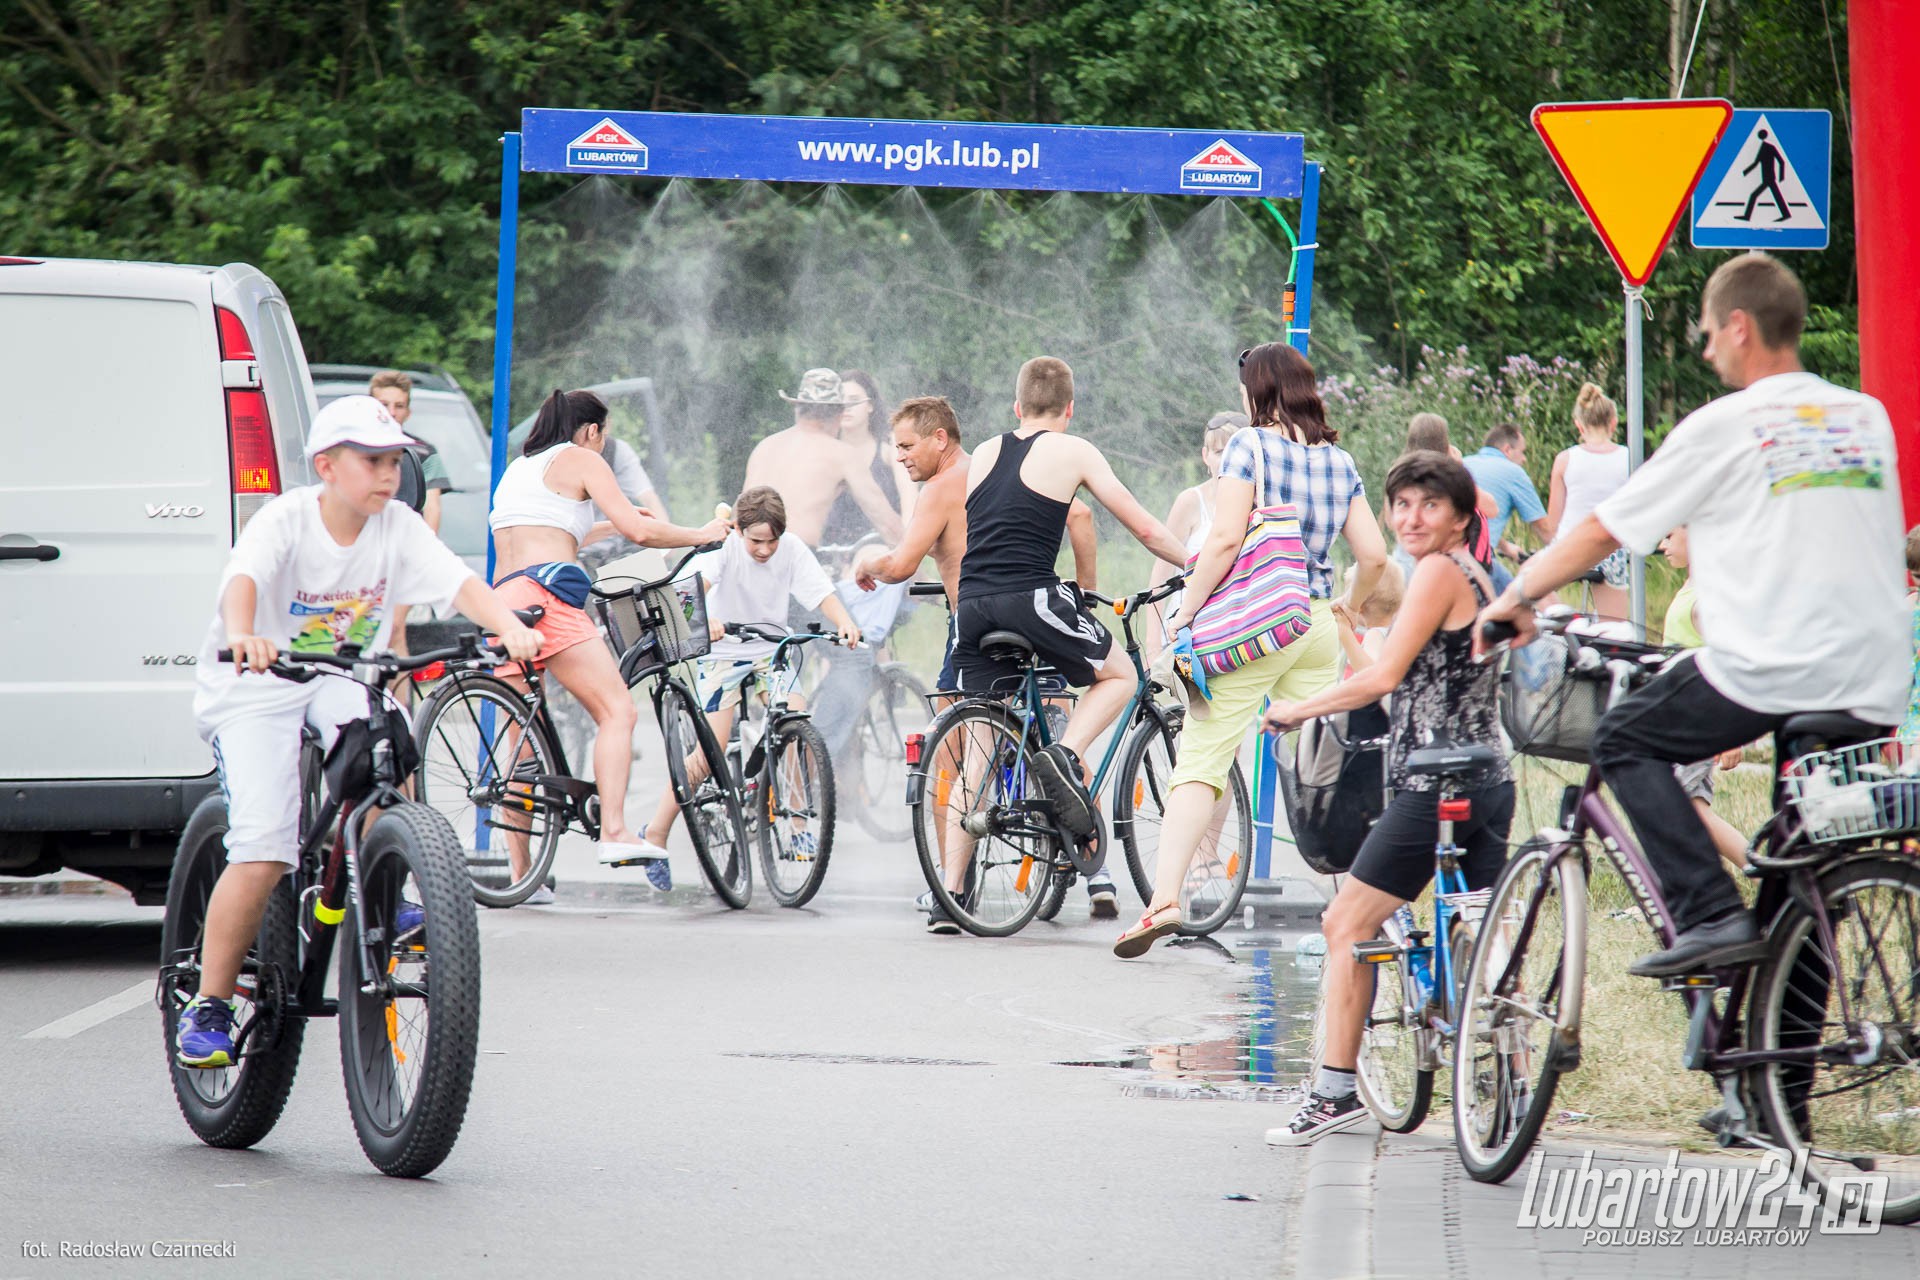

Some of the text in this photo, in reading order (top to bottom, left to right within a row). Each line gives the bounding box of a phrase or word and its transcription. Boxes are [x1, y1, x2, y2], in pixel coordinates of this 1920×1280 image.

[596, 133, 619, 143] PGK
[577, 151, 639, 163] LUBARTÓW
[798, 139, 1040, 175] www.pgk.lub.pl
[1210, 154, 1233, 164] PGK
[1191, 172, 1252, 185] LUBARTÓW
[171, 655, 198, 666] CD
